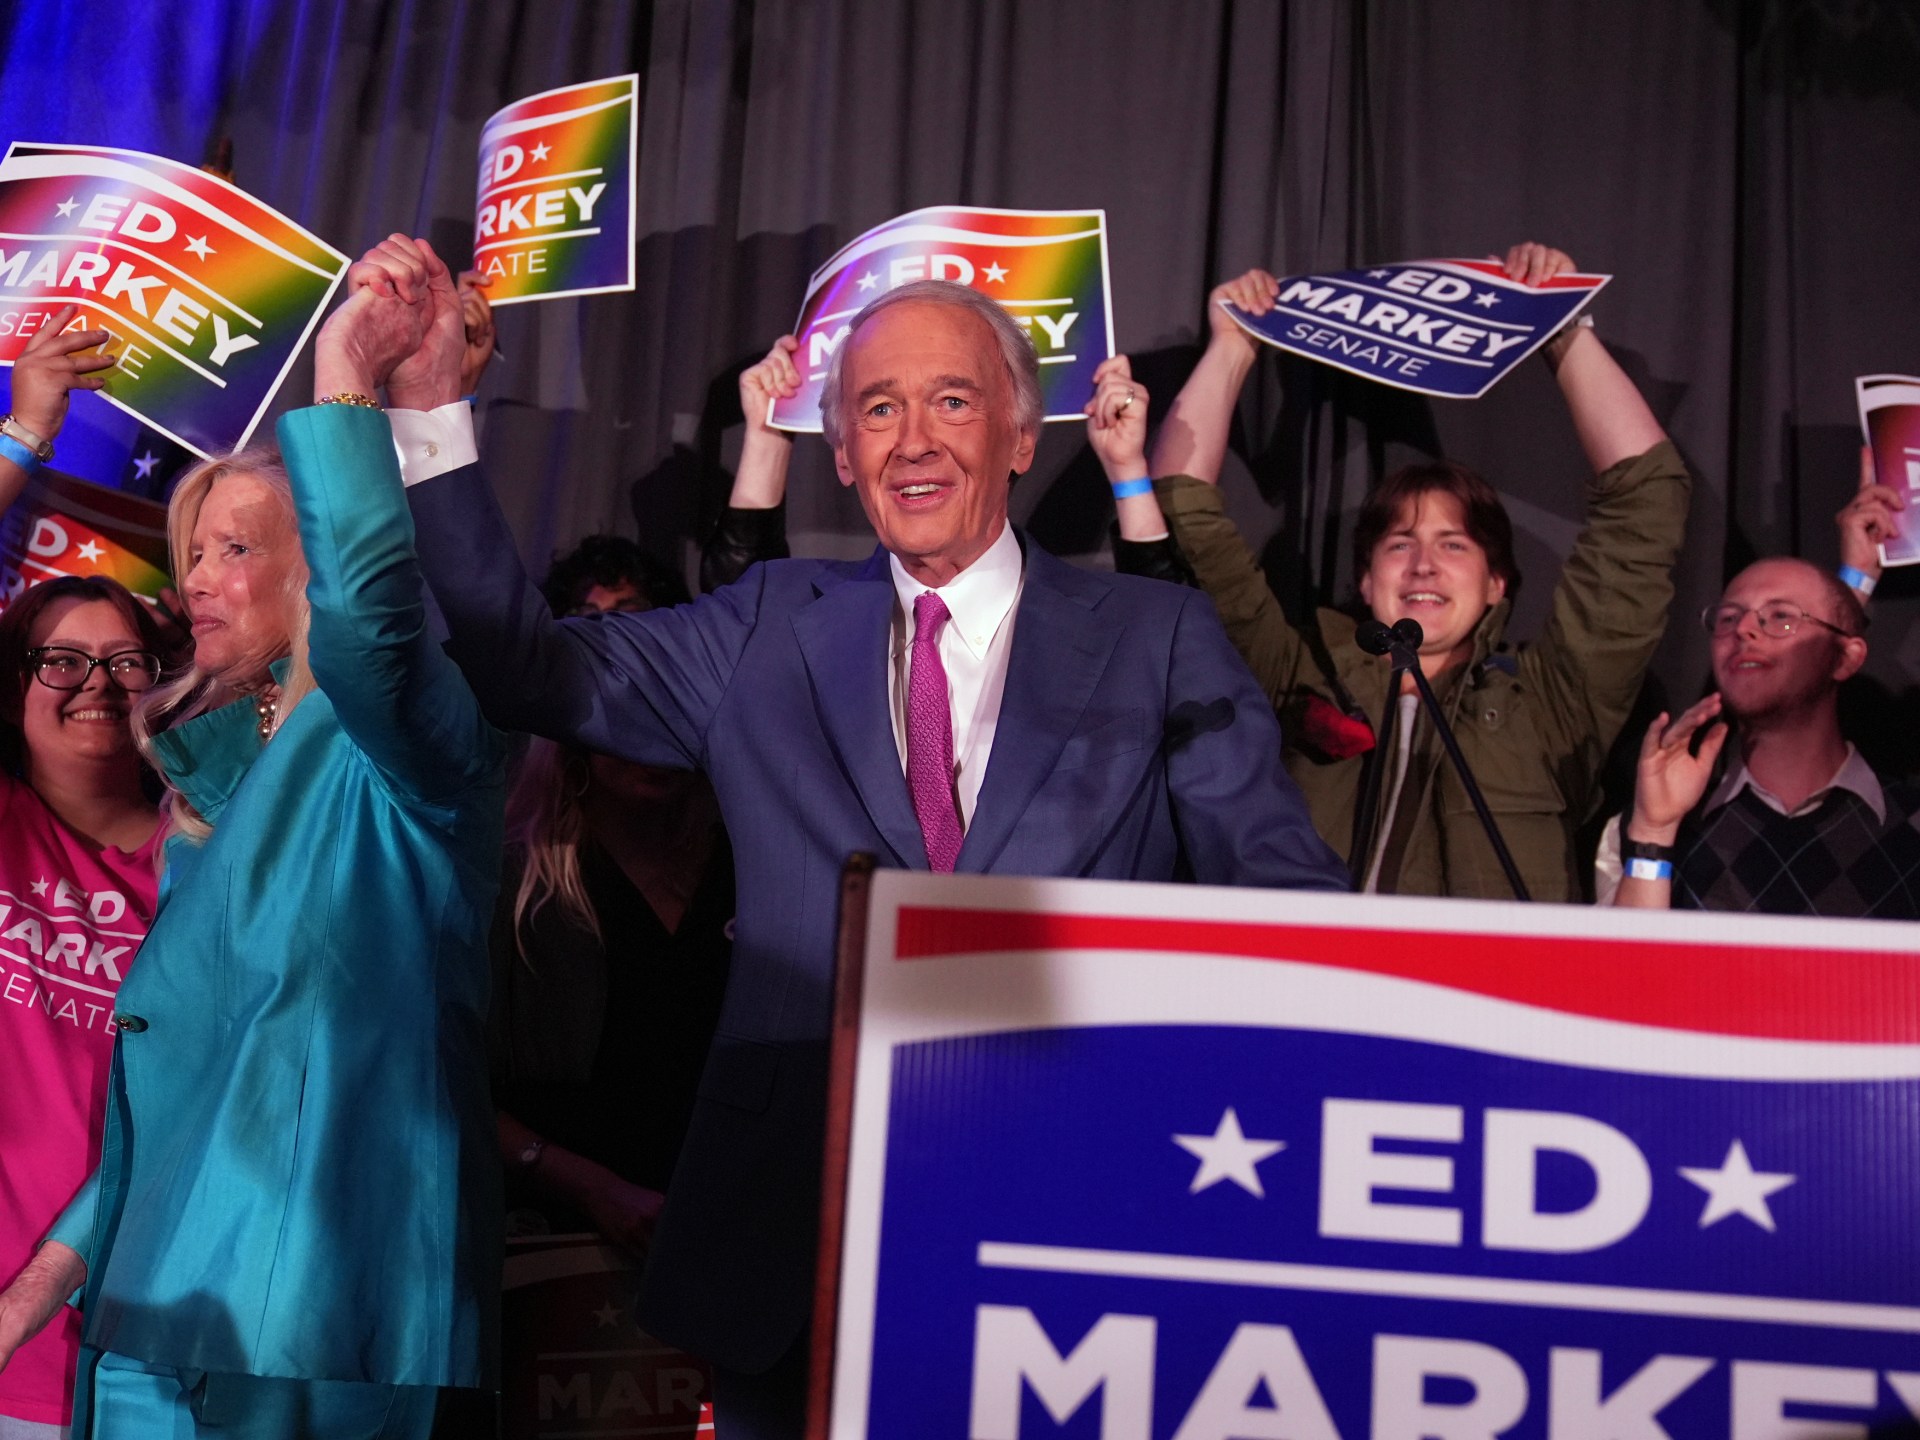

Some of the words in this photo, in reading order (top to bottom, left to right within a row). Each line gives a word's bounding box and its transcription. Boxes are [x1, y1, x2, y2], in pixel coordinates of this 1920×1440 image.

[478, 144, 525, 193] ED
[78, 193, 177, 243] ED
[476, 182, 607, 242] RKEY
[0, 248, 260, 367] MARKEY
[1386, 269, 1472, 302] ED
[1278, 280, 1529, 358] MARKEY
[1286, 322, 1430, 377] SENATE
[53, 876, 126, 924] ED
[0, 904, 132, 982] ARK
[0, 966, 118, 1036] ENATE
[1319, 1097, 1653, 1254] ED
[538, 1367, 708, 1421] MAR
